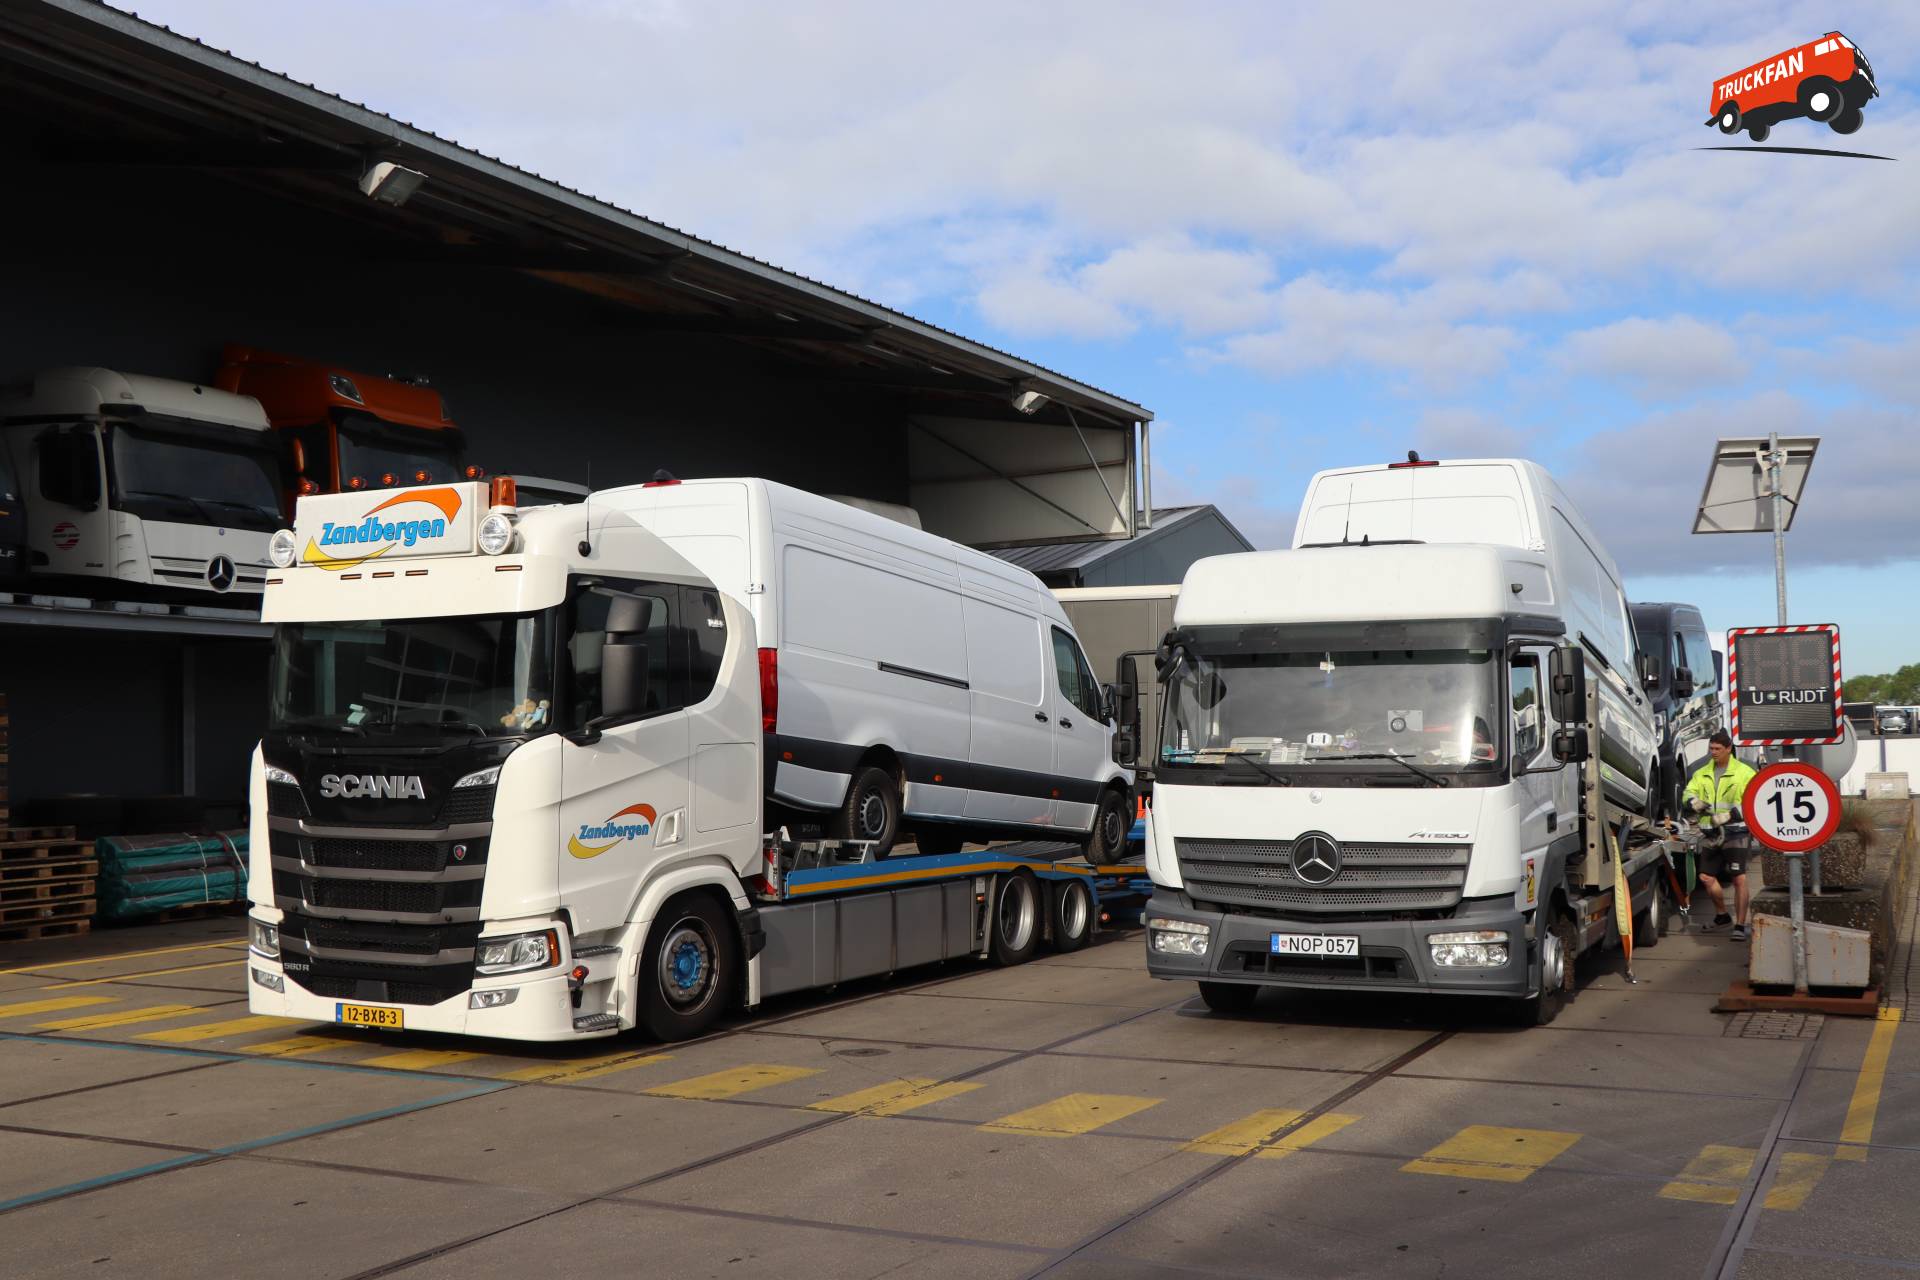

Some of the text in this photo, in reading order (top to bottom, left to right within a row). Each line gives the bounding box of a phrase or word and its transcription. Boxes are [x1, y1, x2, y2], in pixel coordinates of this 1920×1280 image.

[320, 516, 445, 547] Zandbergen
[1752, 690, 1828, 705] U RIJDT
[320, 774, 425, 799] SCANIA
[1775, 778, 1804, 788] MAX
[1767, 791, 1816, 823] 15
[579, 822, 650, 841] Zandbergen
[1777, 826, 1810, 836] Km/h
[1289, 937, 1356, 953] NOP 057
[347, 1007, 397, 1025] 12-BXB-3
